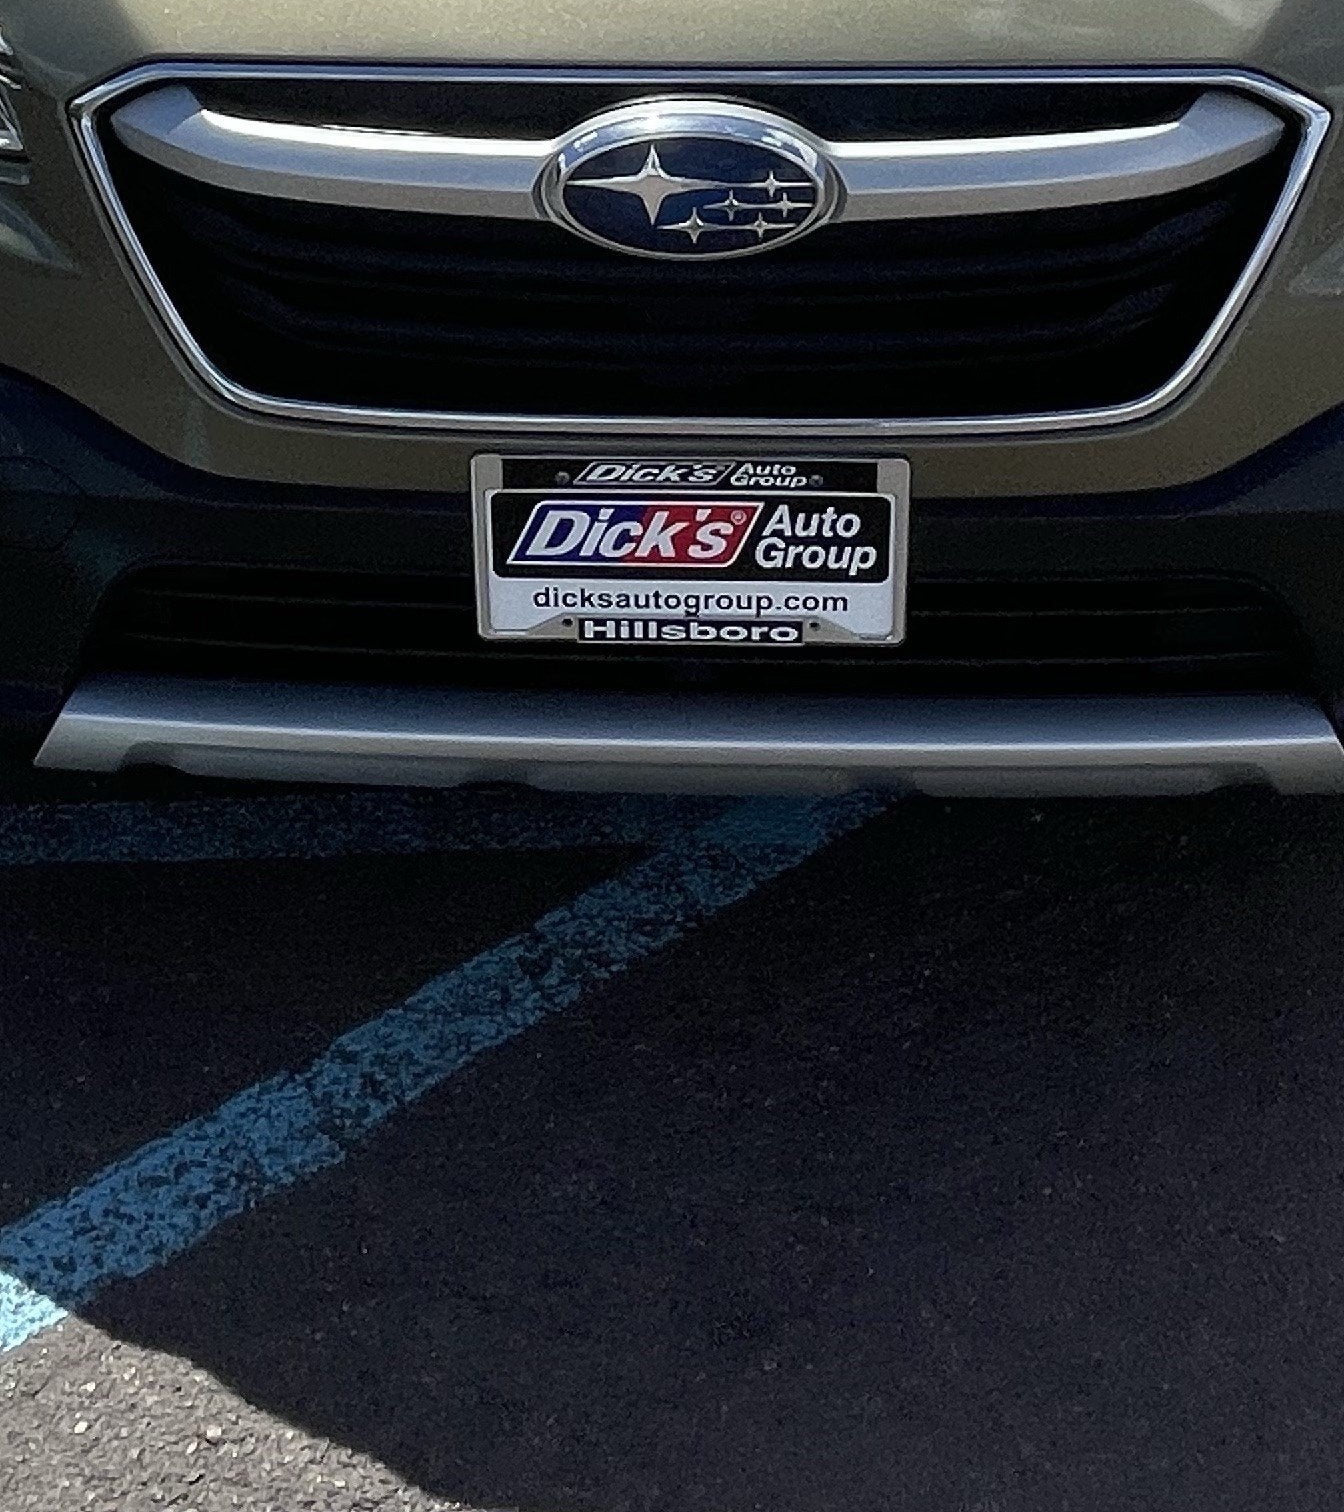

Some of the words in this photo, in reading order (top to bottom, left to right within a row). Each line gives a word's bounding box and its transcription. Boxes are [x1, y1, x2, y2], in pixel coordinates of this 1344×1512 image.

[586, 464, 718, 482] Dick's
[730, 474, 807, 487] Group
[736, 462, 796, 476] Auto
[525, 508, 734, 559] Dick's
[761, 504, 861, 538] Auto
[755, 537, 877, 575] Group
[533, 587, 849, 617] dicksautogroup.com
[583, 620, 799, 642] Hillsboro
